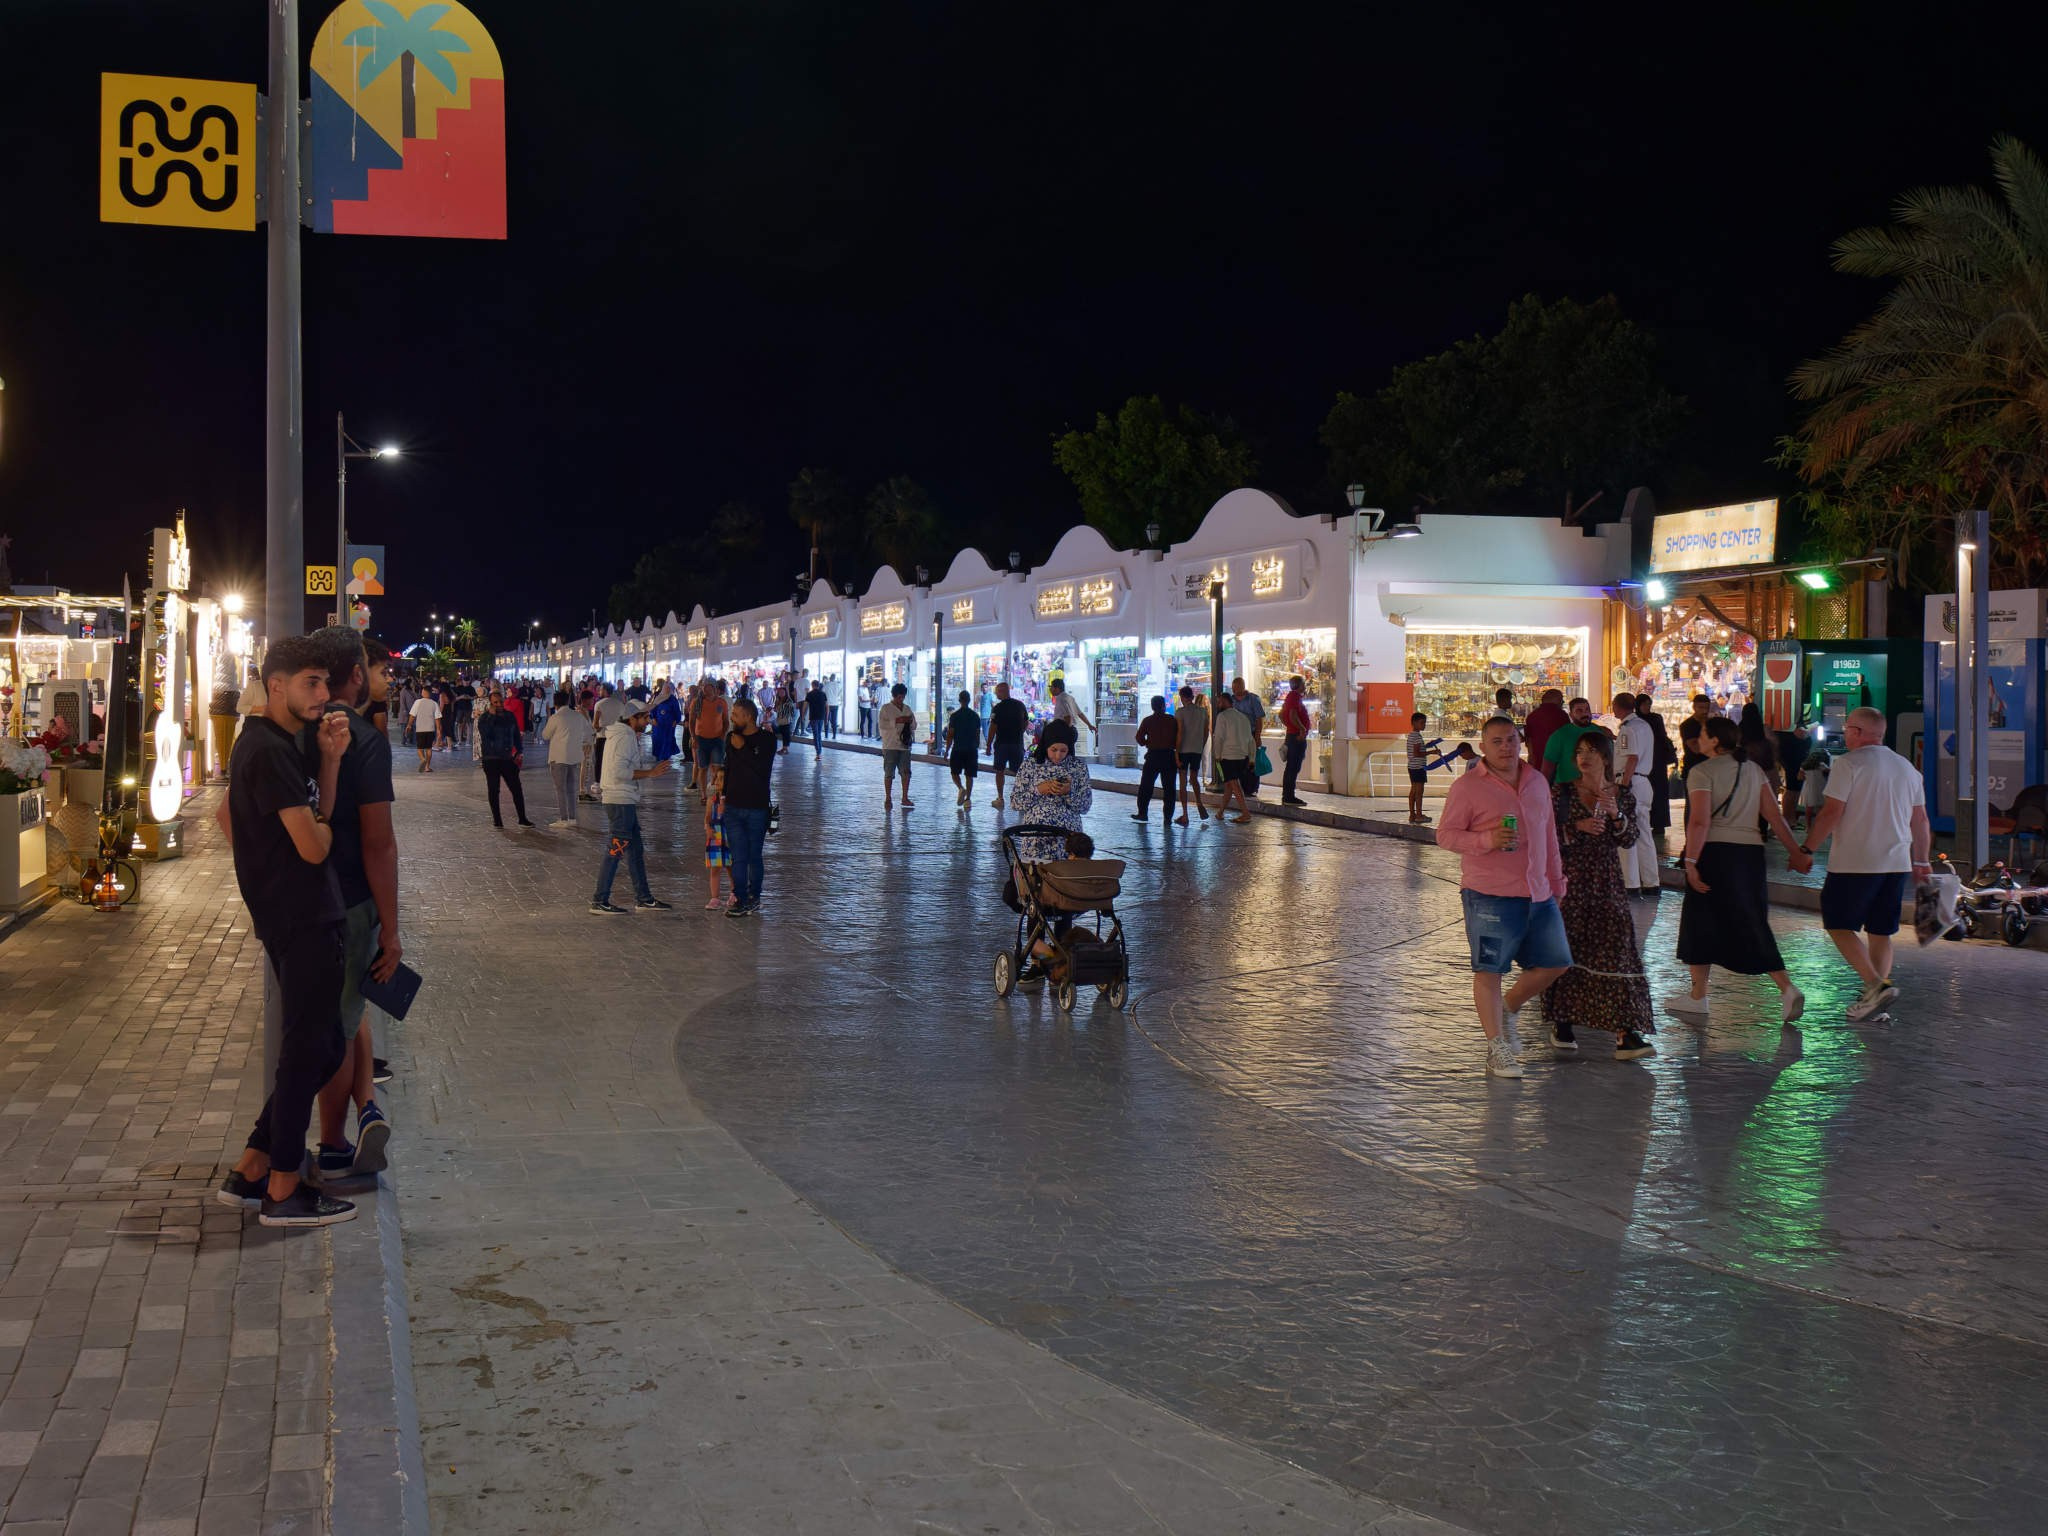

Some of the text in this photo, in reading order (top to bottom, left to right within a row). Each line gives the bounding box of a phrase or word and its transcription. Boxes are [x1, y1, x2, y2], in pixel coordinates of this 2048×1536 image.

[1665, 527, 1761, 554] SHOPPING CENTER
[1769, 641, 1788, 652] ATM
